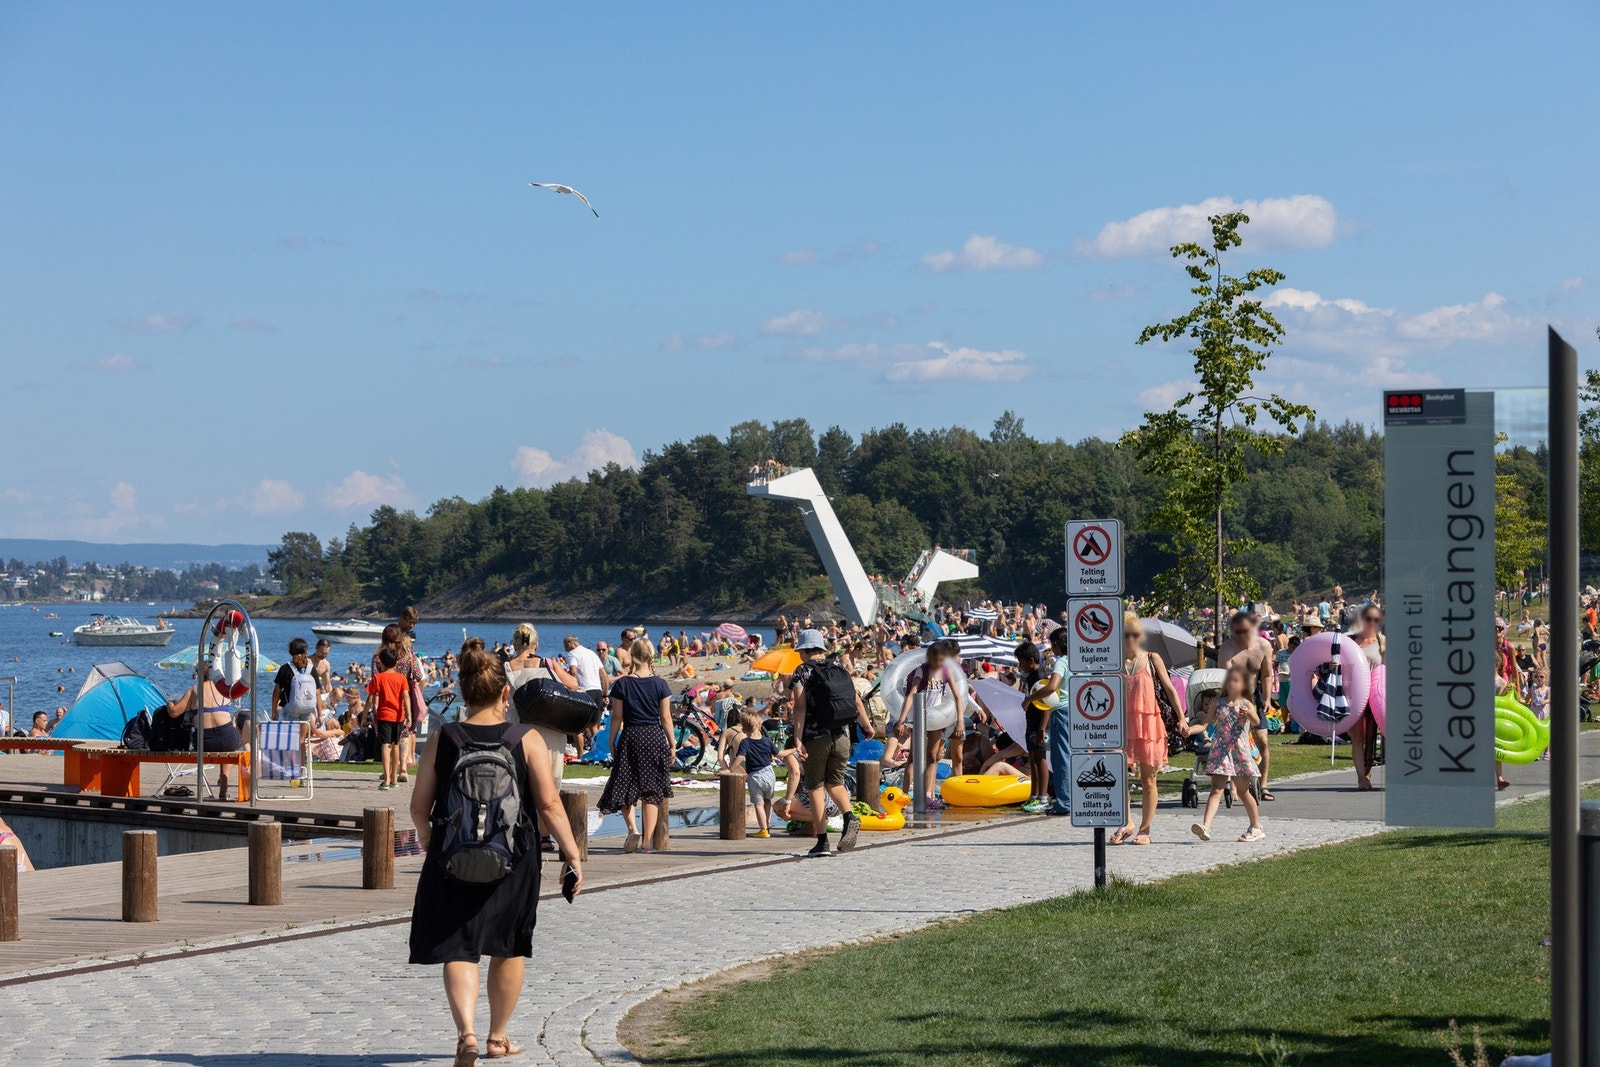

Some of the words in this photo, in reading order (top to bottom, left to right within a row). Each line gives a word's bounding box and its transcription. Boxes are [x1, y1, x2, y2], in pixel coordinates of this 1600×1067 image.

[1080, 568, 1105, 576] Telting
[1079, 577, 1106, 585] forbudt
[1403, 594, 1423, 616] til
[1437, 449, 1484, 773] Kadettangen
[1081, 655, 1108, 663] fuglene
[1403, 625, 1423, 777] Velkommen
[1073, 723, 1090, 731] Hold
[1089, 732, 1107, 740] bånd
[1084, 792, 1110, 800] Grilling
[1103, 801, 1112, 810] på
